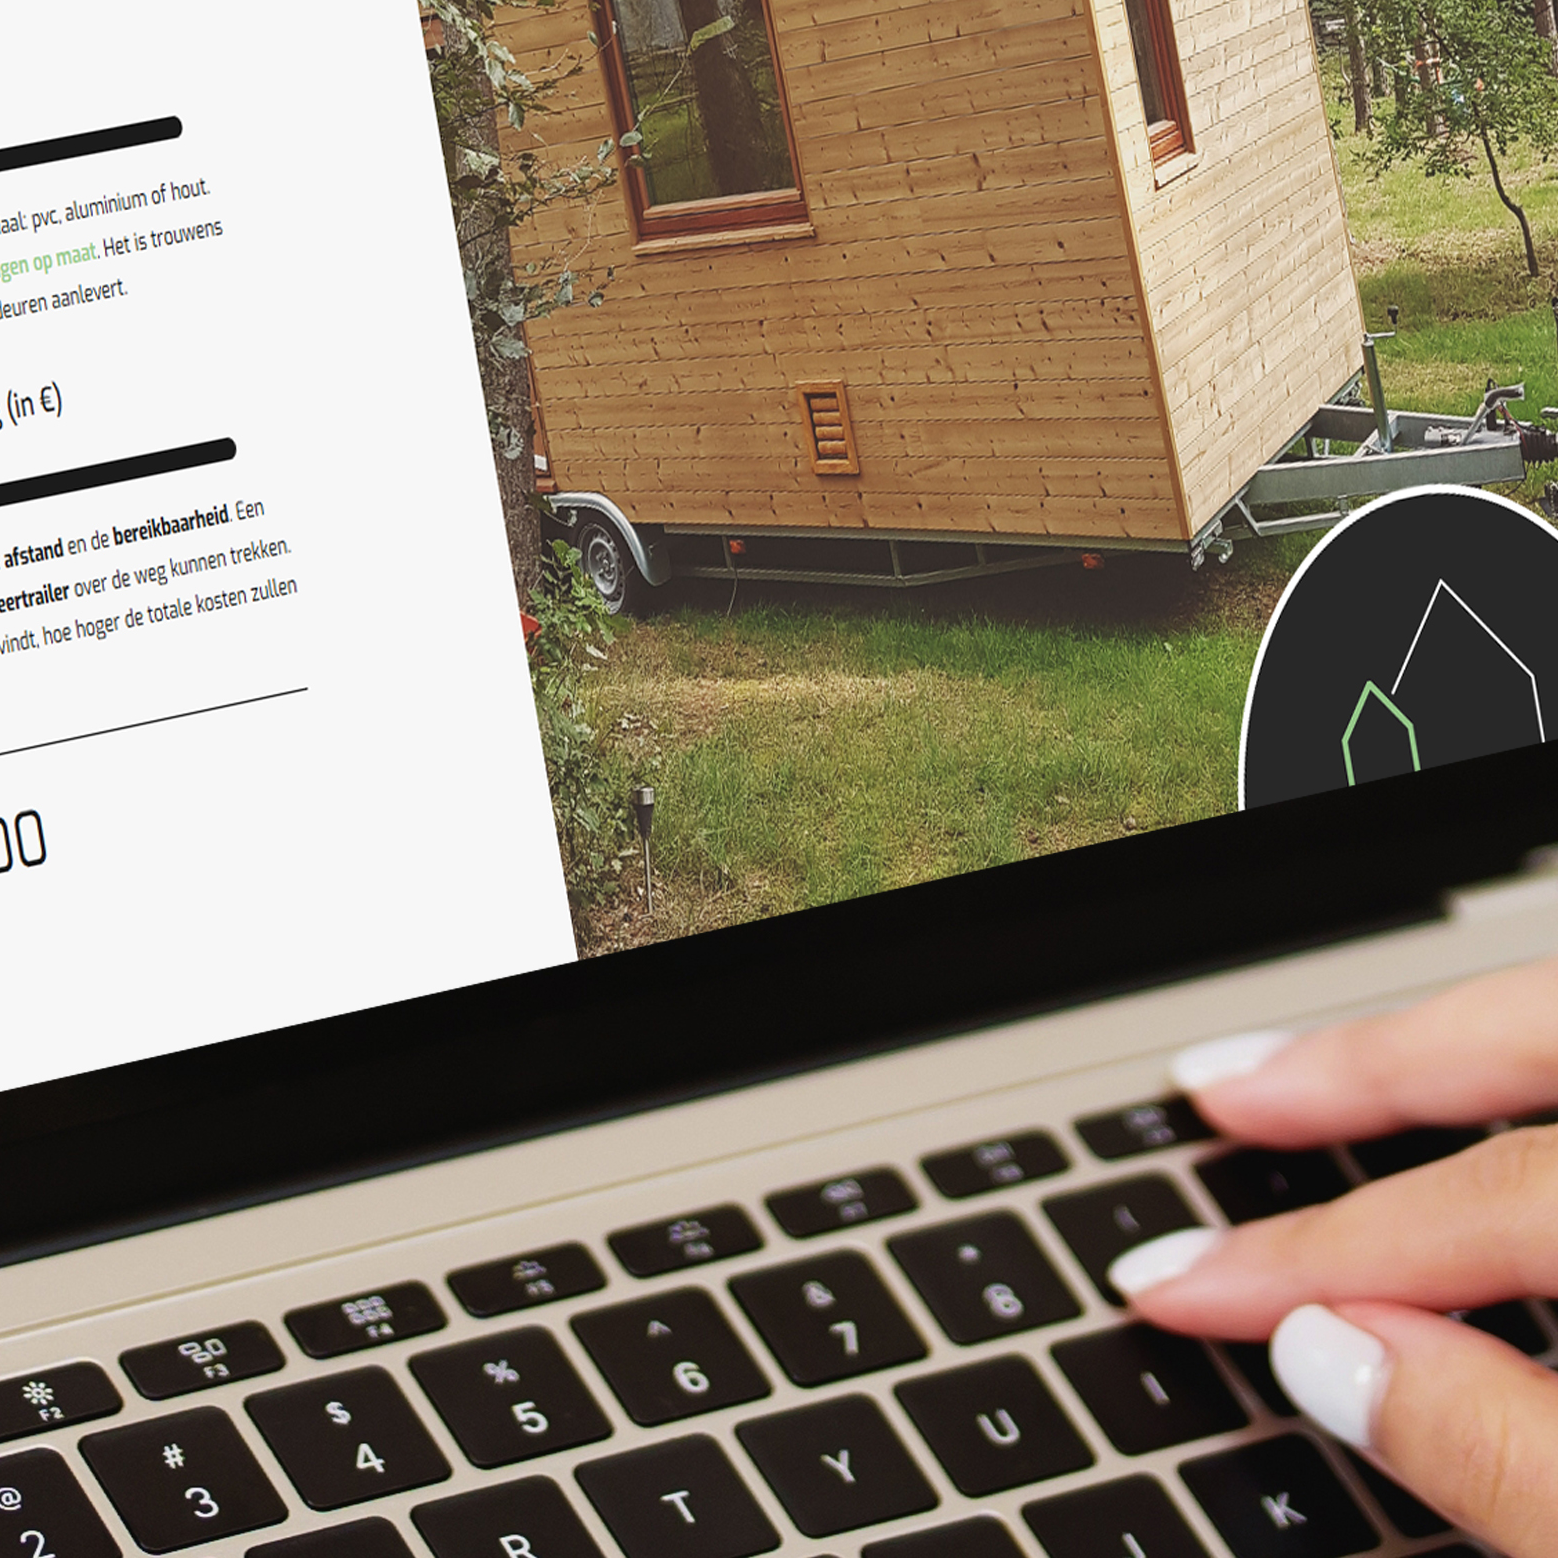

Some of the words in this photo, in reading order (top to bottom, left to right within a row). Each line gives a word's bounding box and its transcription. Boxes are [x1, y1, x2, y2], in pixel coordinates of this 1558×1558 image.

[32, 254, 53, 275] op
[55, 242, 101, 267] maat.
[102, 235, 132, 257] Het
[132, 232, 148, 251] is
[149, 220, 224, 249] trouwens
[51, 278, 129, 310] aanlevert.
[6, 389, 36, 427] (in
[39, 380, 63, 418] €)
[3, 537, 65, 569] afstand
[67, 538, 88, 556] en
[90, 529, 111, 551] de
[111, 503, 233, 546] bereikbaarheid.
[234, 500, 265, 521] Een
[985, 1285, 1022, 1317] 8
[831, 1322, 858, 1353] 7
[484, 1361, 519, 1383] %
[674, 1362, 709, 1393] 6
[38, 1405, 65, 1422] F2
[326, 1402, 351, 1424] $
[512, 1402, 547, 1433] 5
[978, 1410, 1019, 1444] U
[163, 1444, 183, 1468] #
[357, 1444, 384, 1472] 4
[822, 1450, 854, 1481] Y
[185, 1488, 218, 1517] 3
[661, 1491, 694, 1522] T
[1264, 1494, 1305, 1526] K
